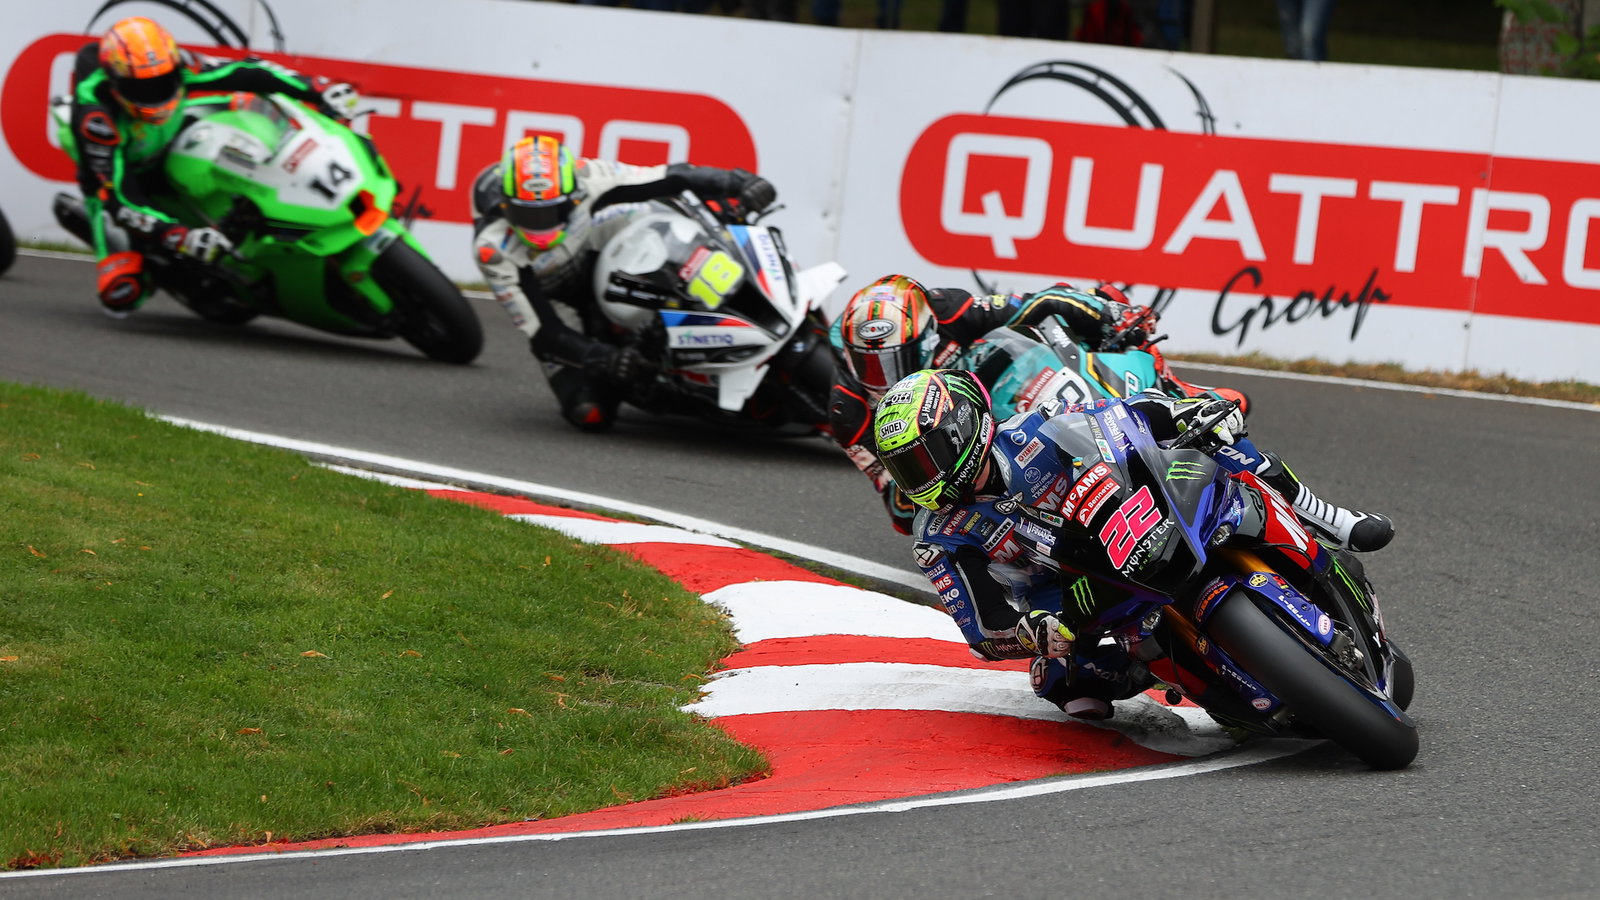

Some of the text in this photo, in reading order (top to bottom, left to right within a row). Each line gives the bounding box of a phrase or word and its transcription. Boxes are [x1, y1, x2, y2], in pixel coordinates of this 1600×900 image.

[310, 161, 354, 200] 14
[688, 250, 744, 309] 18
[1211, 266, 1392, 348] Group
[678, 333, 734, 346] SYNETIQ
[1026, 368, 1055, 400] Bennetts
[880, 421, 902, 436] SHOEI
[1021, 441, 1039, 459] YAMAHA
[1062, 465, 1108, 517] McAMS
[1087, 481, 1114, 509] Bennetts
[943, 510, 967, 536] McAMS
[1099, 485, 1162, 569] 22
[1122, 518, 1175, 577] MONSTER
